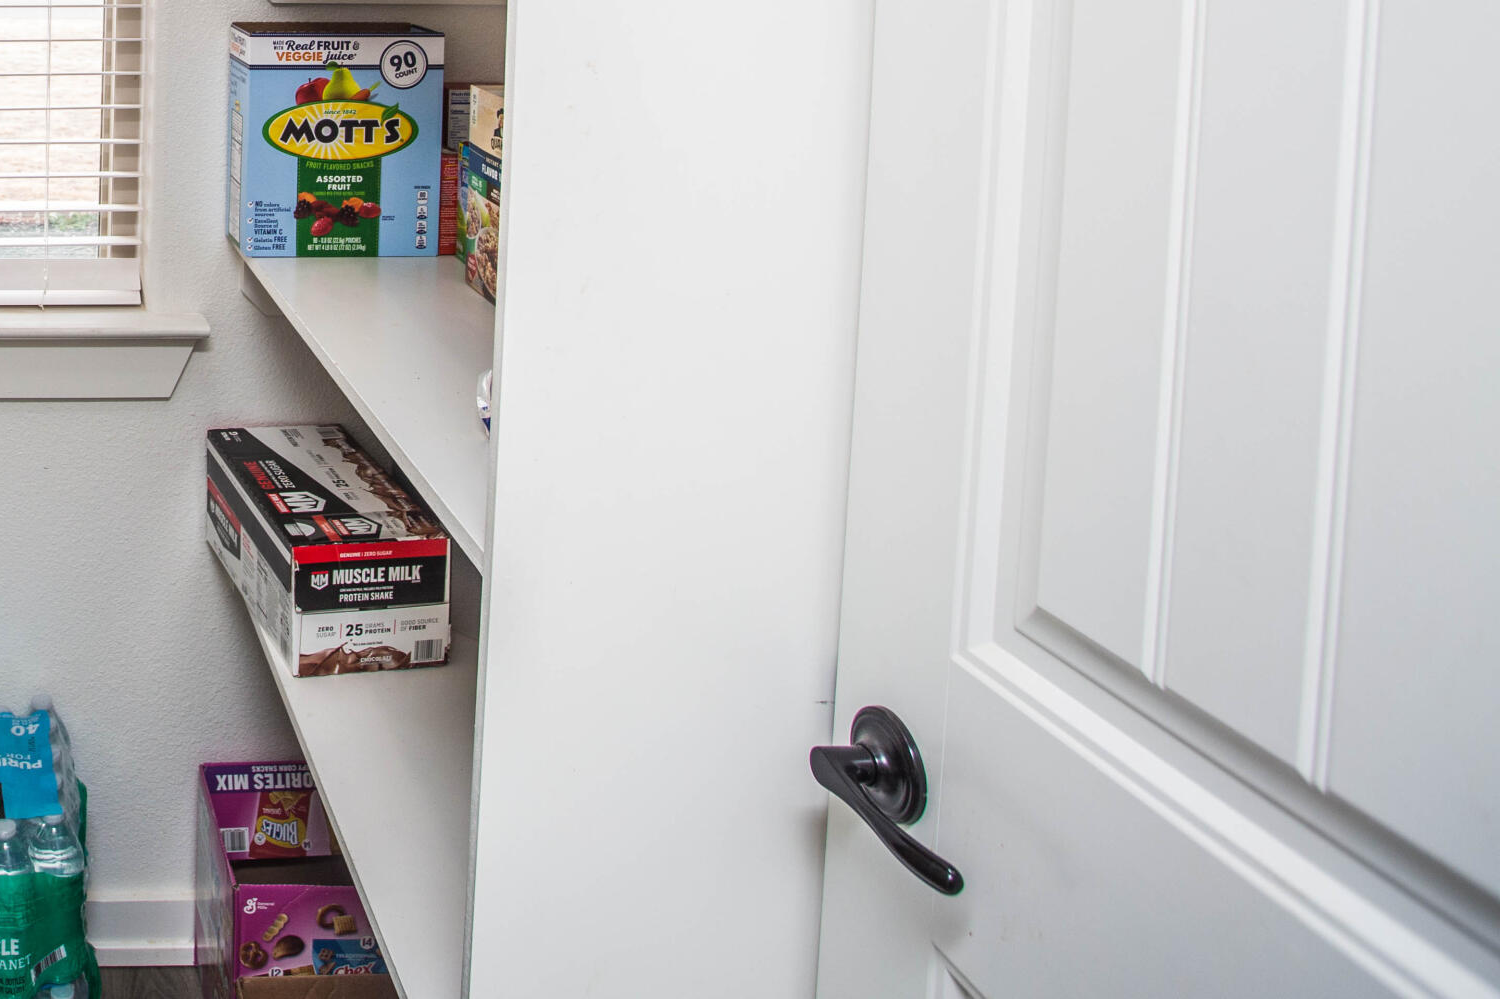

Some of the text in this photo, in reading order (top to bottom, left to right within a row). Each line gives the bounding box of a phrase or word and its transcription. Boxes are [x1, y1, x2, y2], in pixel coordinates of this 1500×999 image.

[285, 39, 316, 51] Real
[317, 40, 351, 51] FRUIT
[276, 51, 323, 62] VEGGIE
[389, 50, 417, 72] 90
[394, 66, 418, 79] COUNT
[305, 160, 375, 170] FRUIT FLAVORED SNACKS
[315, 175, 363, 183] ASSORTED
[327, 183, 351, 191] FRUIT
[332, 566, 386, 585] MUSCLE
[388, 564, 421, 582] MILK
[339, 591, 394, 603] PROTEIN SHAKE
[345, 624, 363, 637] 25
[417, 617, 439, 625] SOURCE
[11, 723, 40, 736] 40
[215, 773, 249, 791] MIX
[261, 818, 299, 846] BUGLES
[362, 937, 373, 947] 14
[334, 962, 375, 975] Chex
